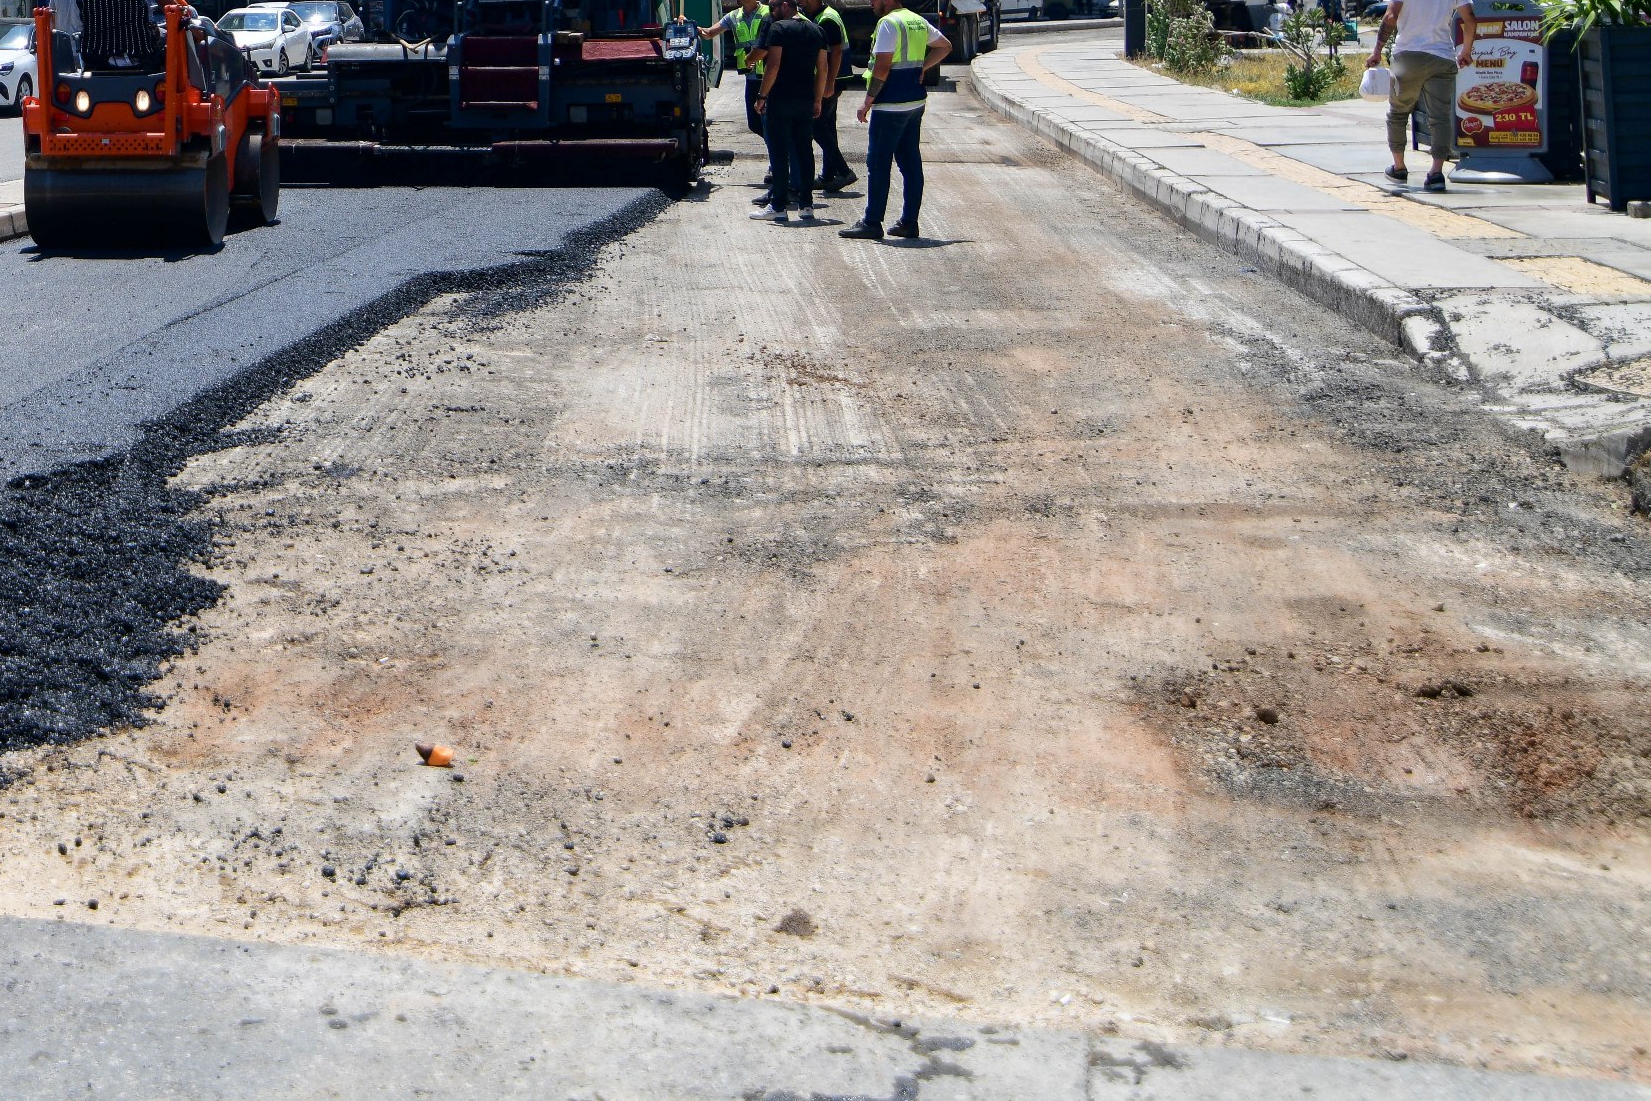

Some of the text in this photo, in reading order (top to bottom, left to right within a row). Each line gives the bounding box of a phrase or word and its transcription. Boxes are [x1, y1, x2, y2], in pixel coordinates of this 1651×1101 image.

[1504, 20, 1539, 31] SALON
[1476, 58, 1503, 68] MENÜ
[1495, 112, 1535, 122] 230 TL
